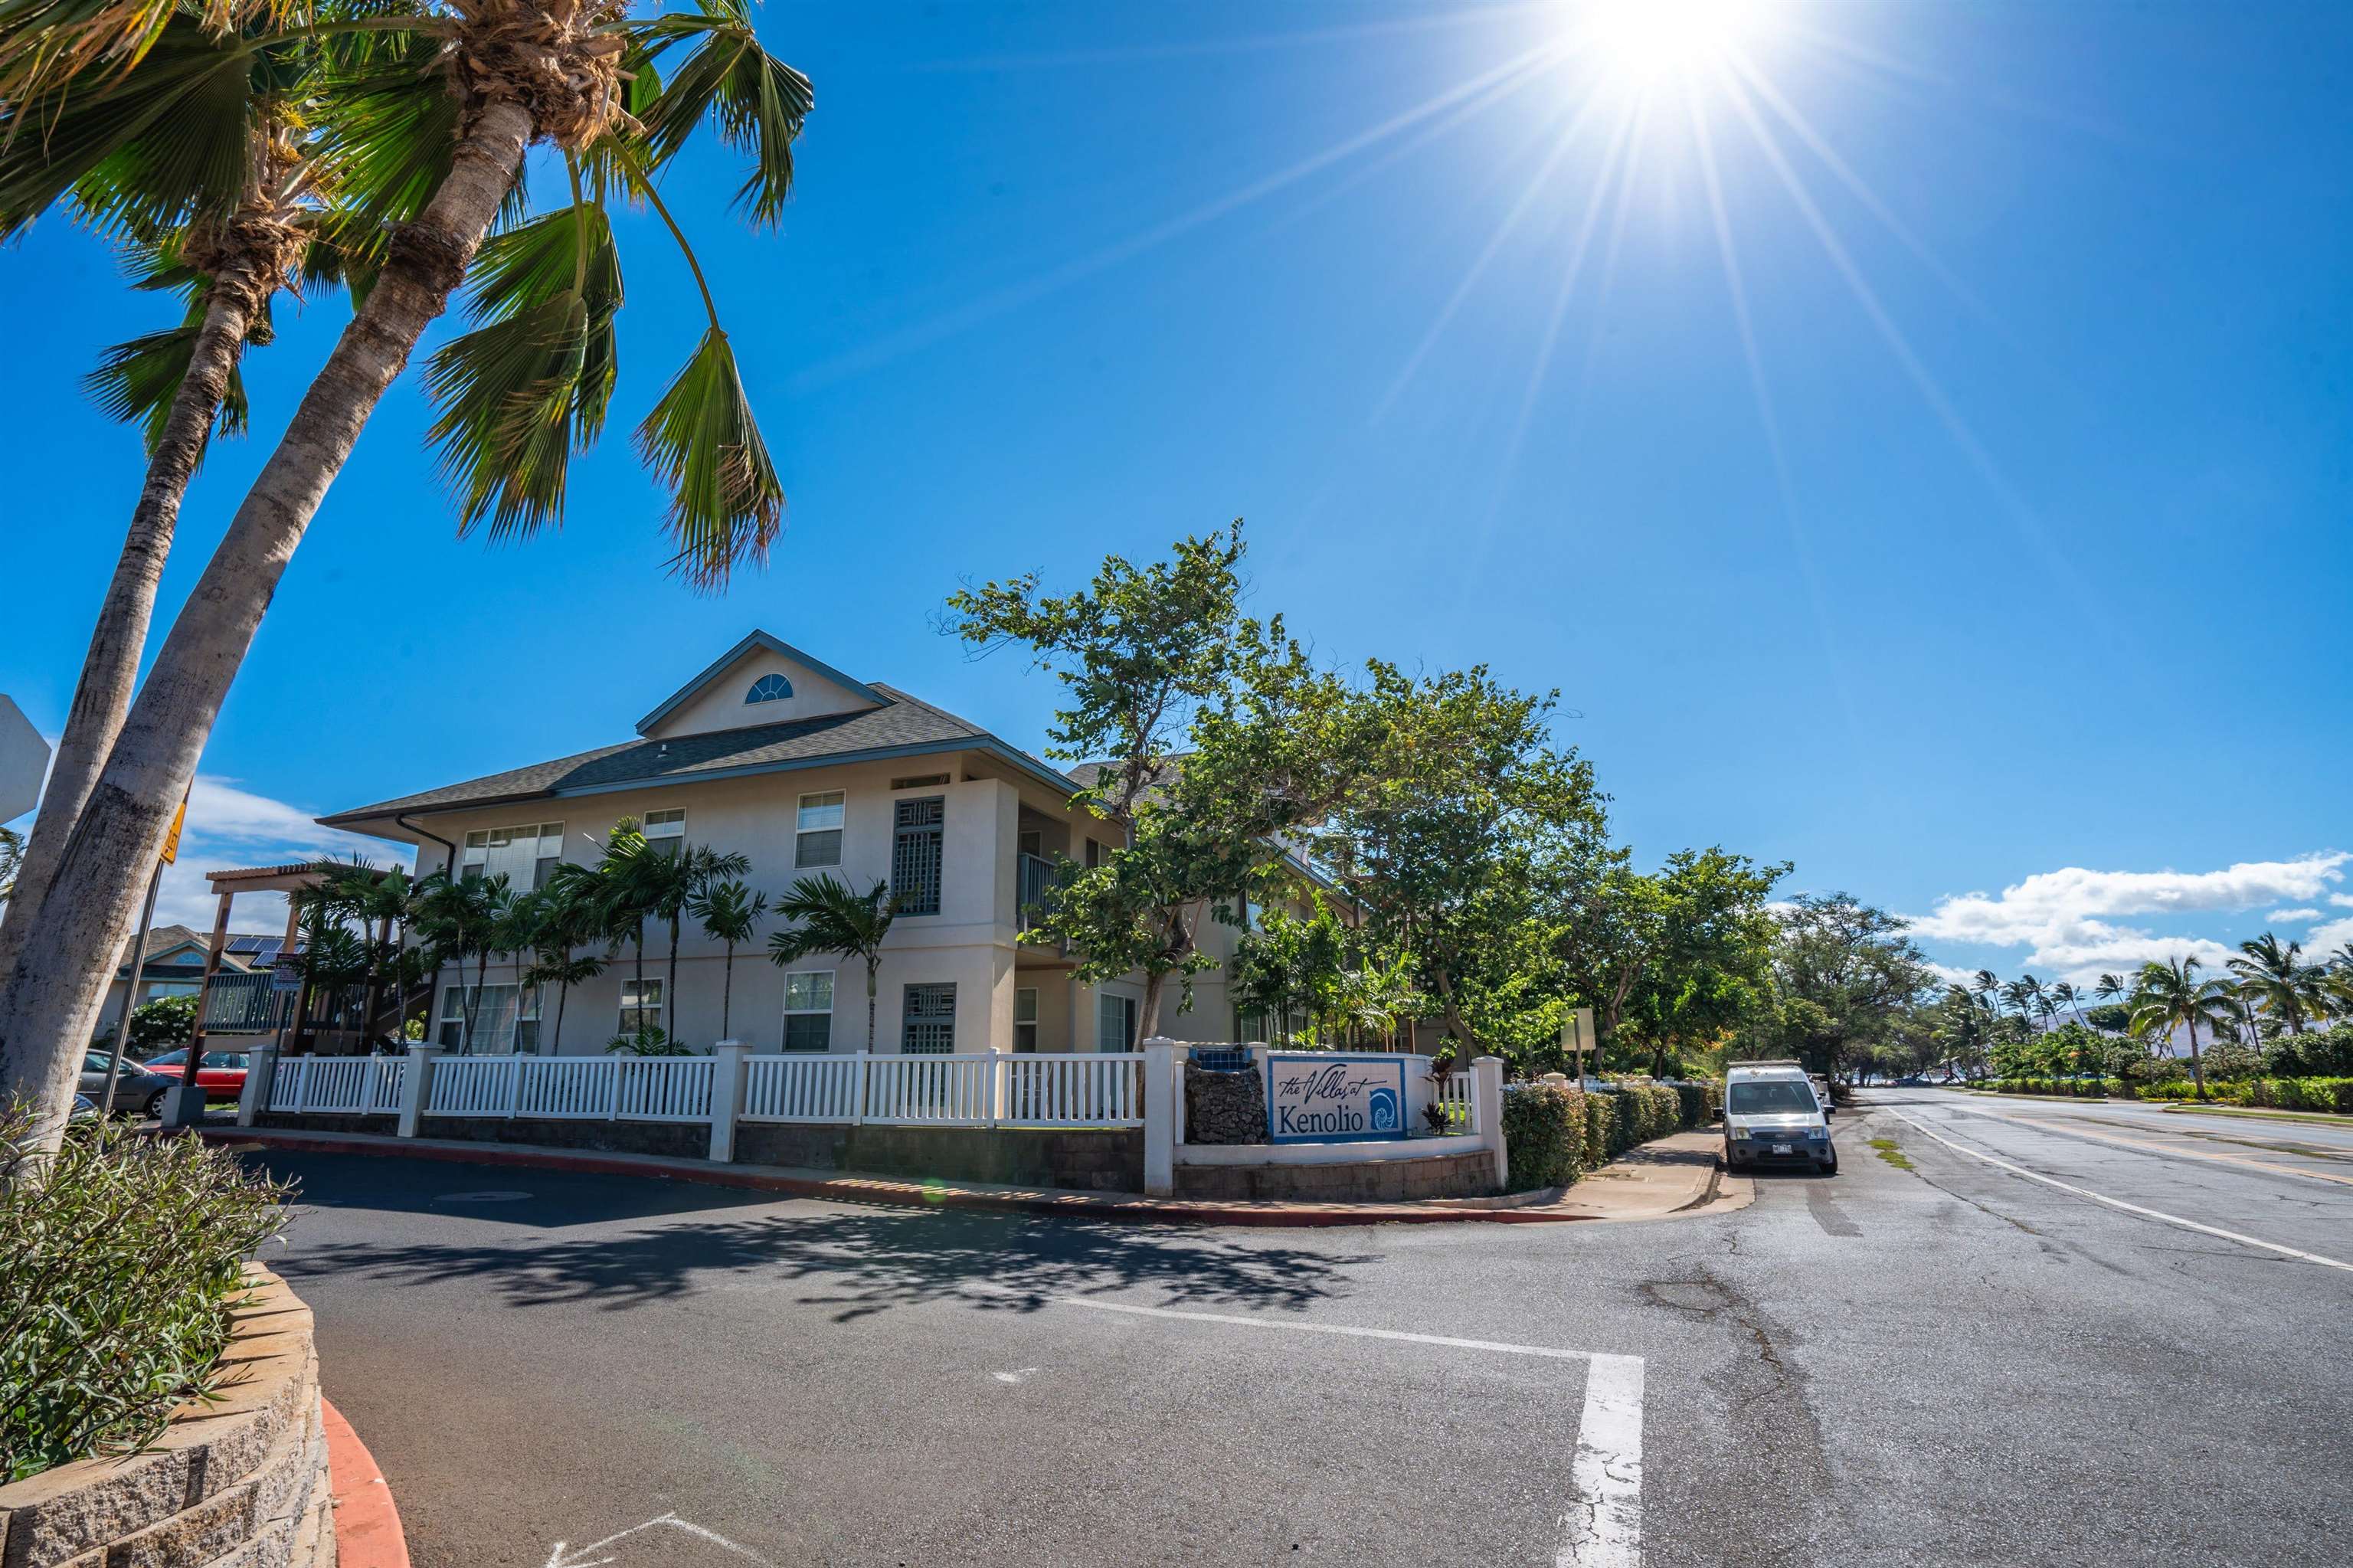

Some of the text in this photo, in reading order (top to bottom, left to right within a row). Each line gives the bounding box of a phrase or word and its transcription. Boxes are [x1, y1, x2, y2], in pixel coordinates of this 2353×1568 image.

[1304, 1063, 1348, 1105] Villas
[1348, 1078, 1387, 1096] at
[1278, 1105, 1363, 1134] Kenolio
